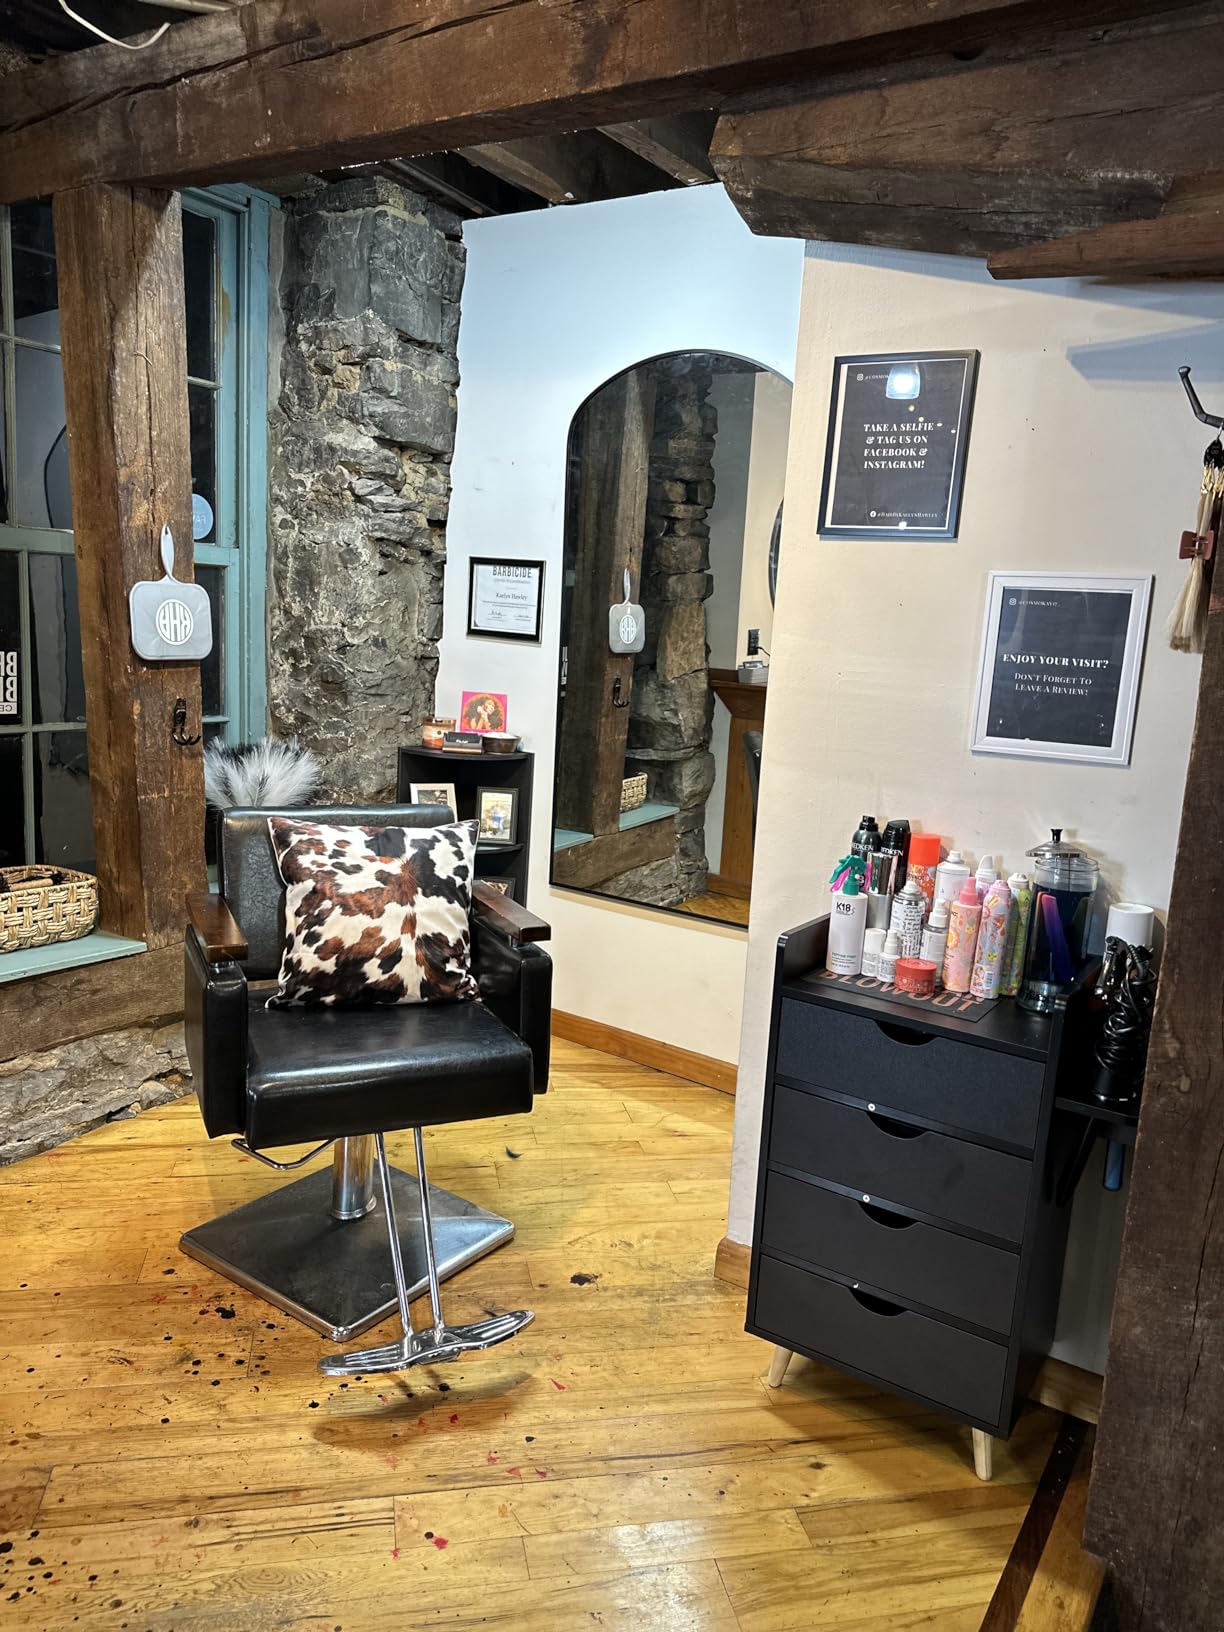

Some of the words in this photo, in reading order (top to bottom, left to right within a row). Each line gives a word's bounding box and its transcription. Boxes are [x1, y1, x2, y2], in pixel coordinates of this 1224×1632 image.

[864, 423, 889, 432] TAKE
[890, 423, 898, 432] A
[899, 422, 935, 431] SELFIE
[865, 436, 875, 444] &
[877, 435, 897, 444] TAG
[898, 435, 911, 444] US
[913, 435, 929, 443] ON
[863, 448, 917, 457] FACEBOOK
[918, 448, 929, 456] &
[863, 460, 925, 469] INSTAGRAM!
[492, 566, 532, 578] BARBICIDE
[1002, 653, 1036, 664] ENJOY
[1039, 655, 1069, 666] YOUR
[1072, 658, 1109, 668] VISIT?
[1043, 685, 1051, 693] A
[836, 901, 851, 912] K18
